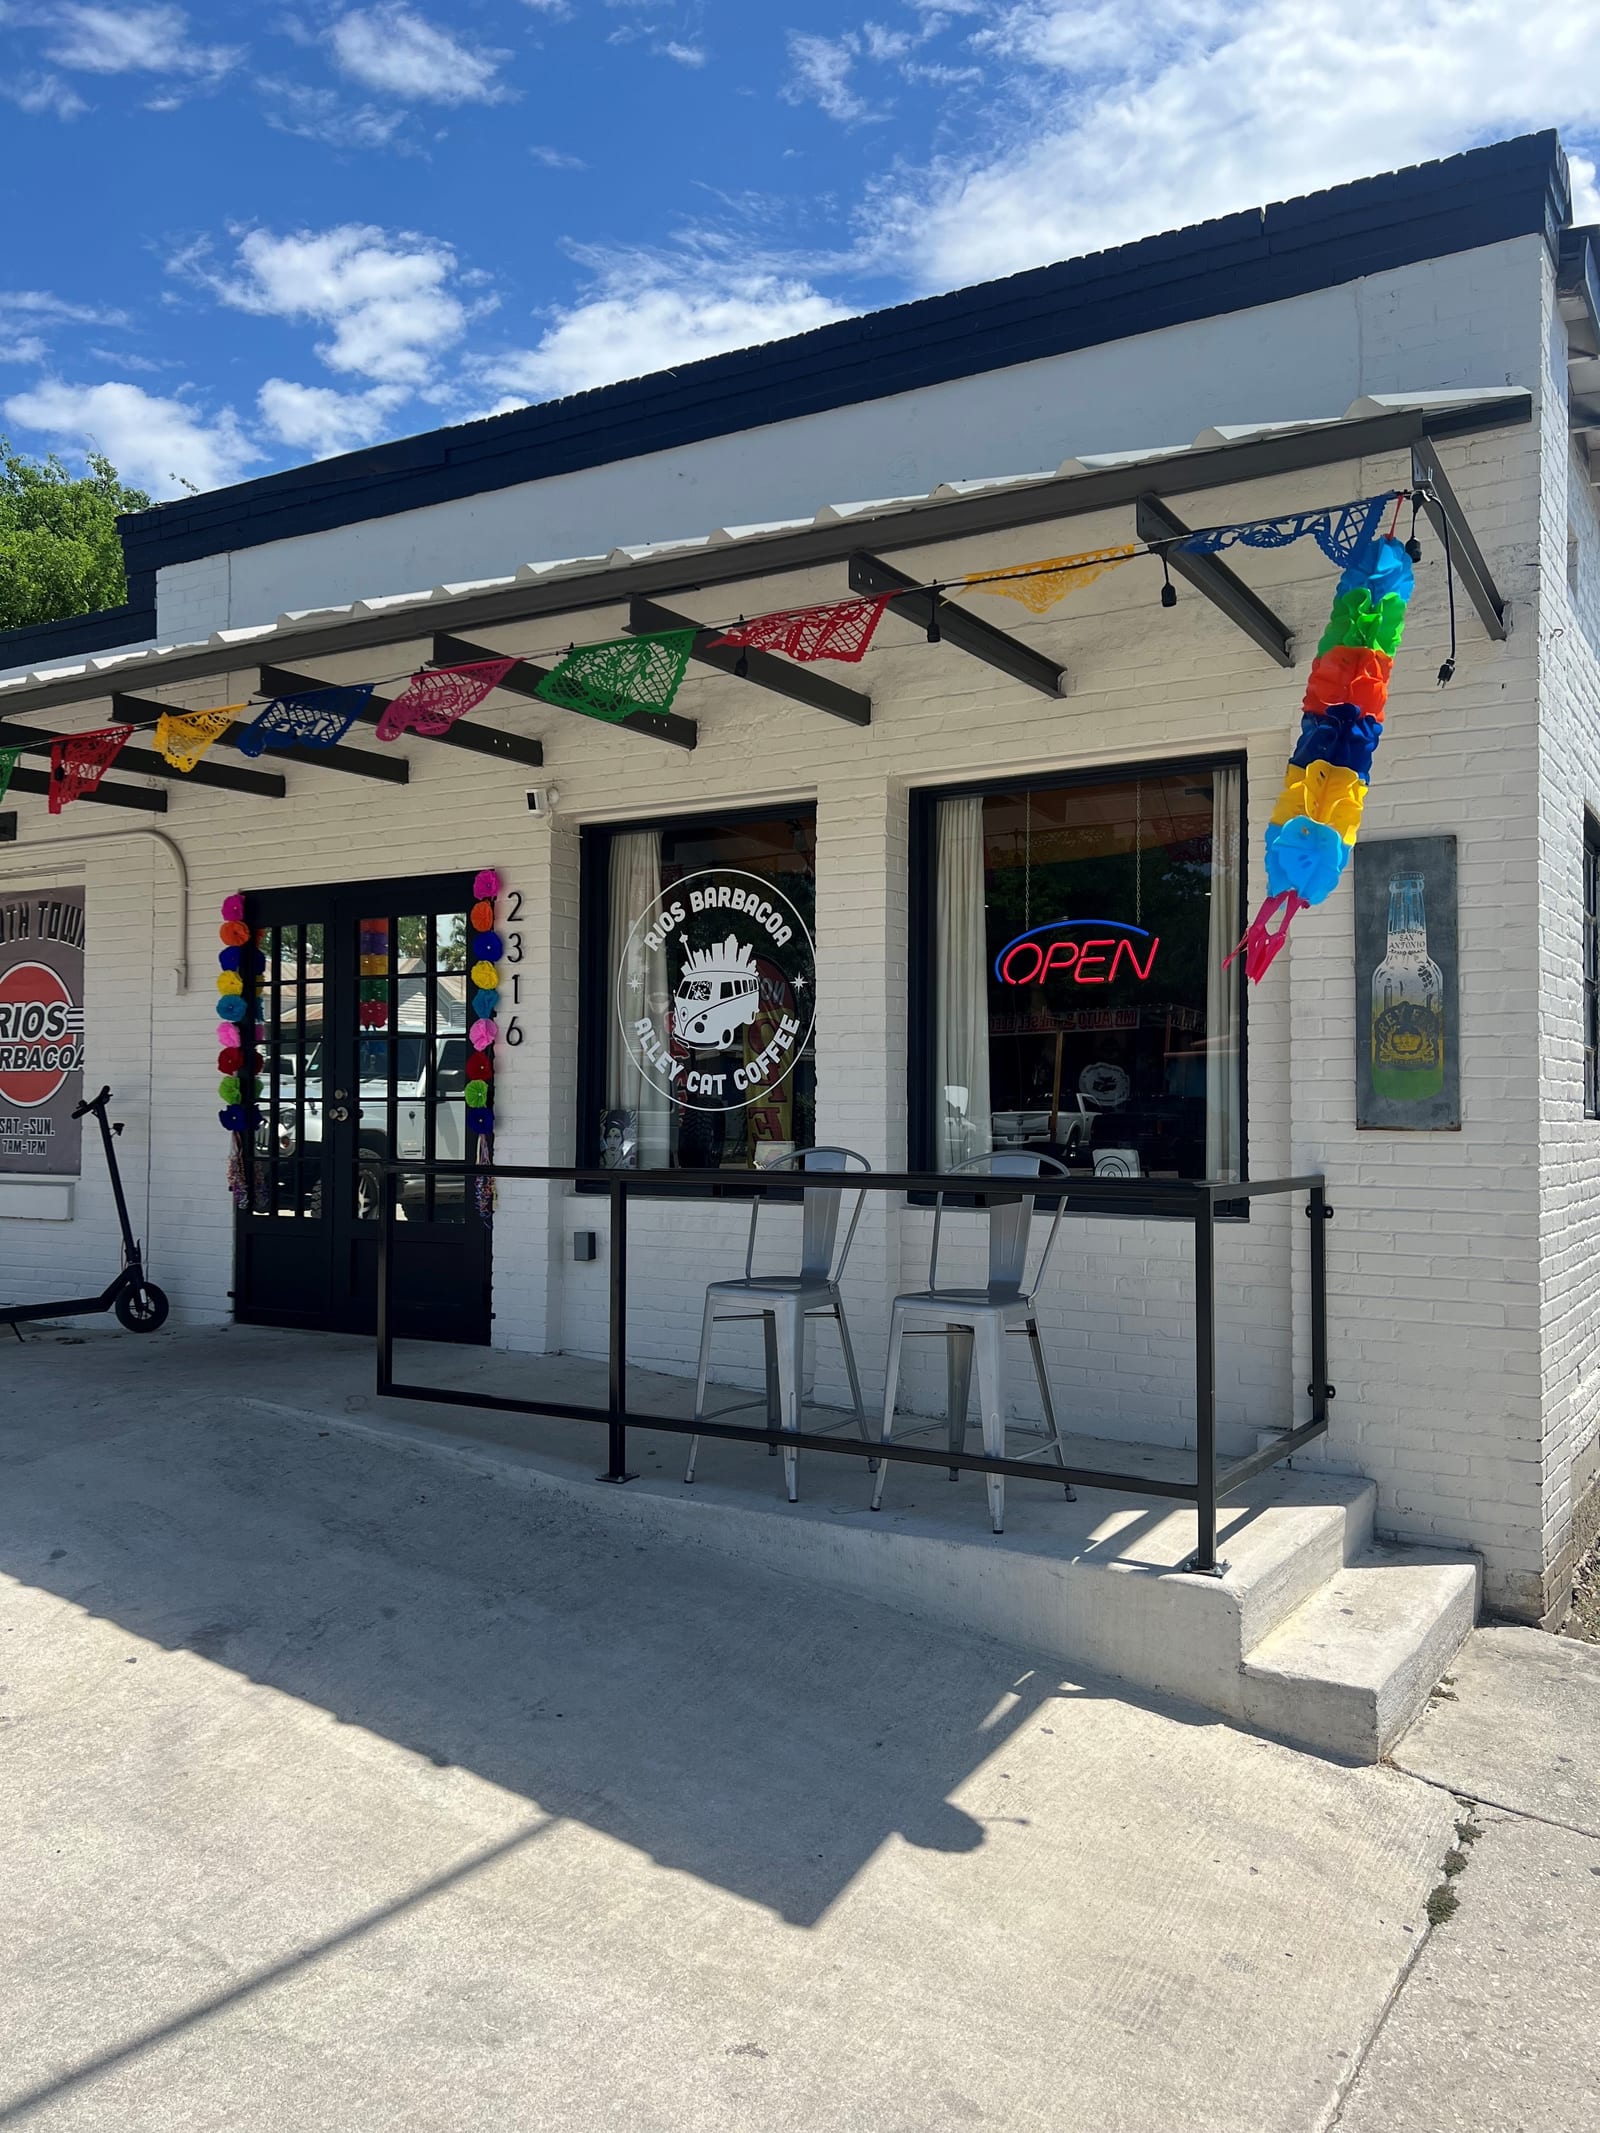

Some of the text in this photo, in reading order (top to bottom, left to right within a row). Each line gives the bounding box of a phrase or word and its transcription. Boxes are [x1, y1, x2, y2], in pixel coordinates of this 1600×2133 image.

[644, 886, 793, 951] RIOS BARBACOA
[1400, 934, 1414, 942] SAN
[1003, 938, 1160, 985] OPEN
[1389, 941, 1426, 949] ANTONIO
[506, 891, 523, 1047] 2316
[0, 1002, 68, 1041] RIOS
[634, 1017, 685, 1081] ALLEY
[687, 1070, 726, 1095] CAT
[734, 1014, 800, 1091] COFFEE
[2, 1139, 47, 1155] 7AM-1PM
